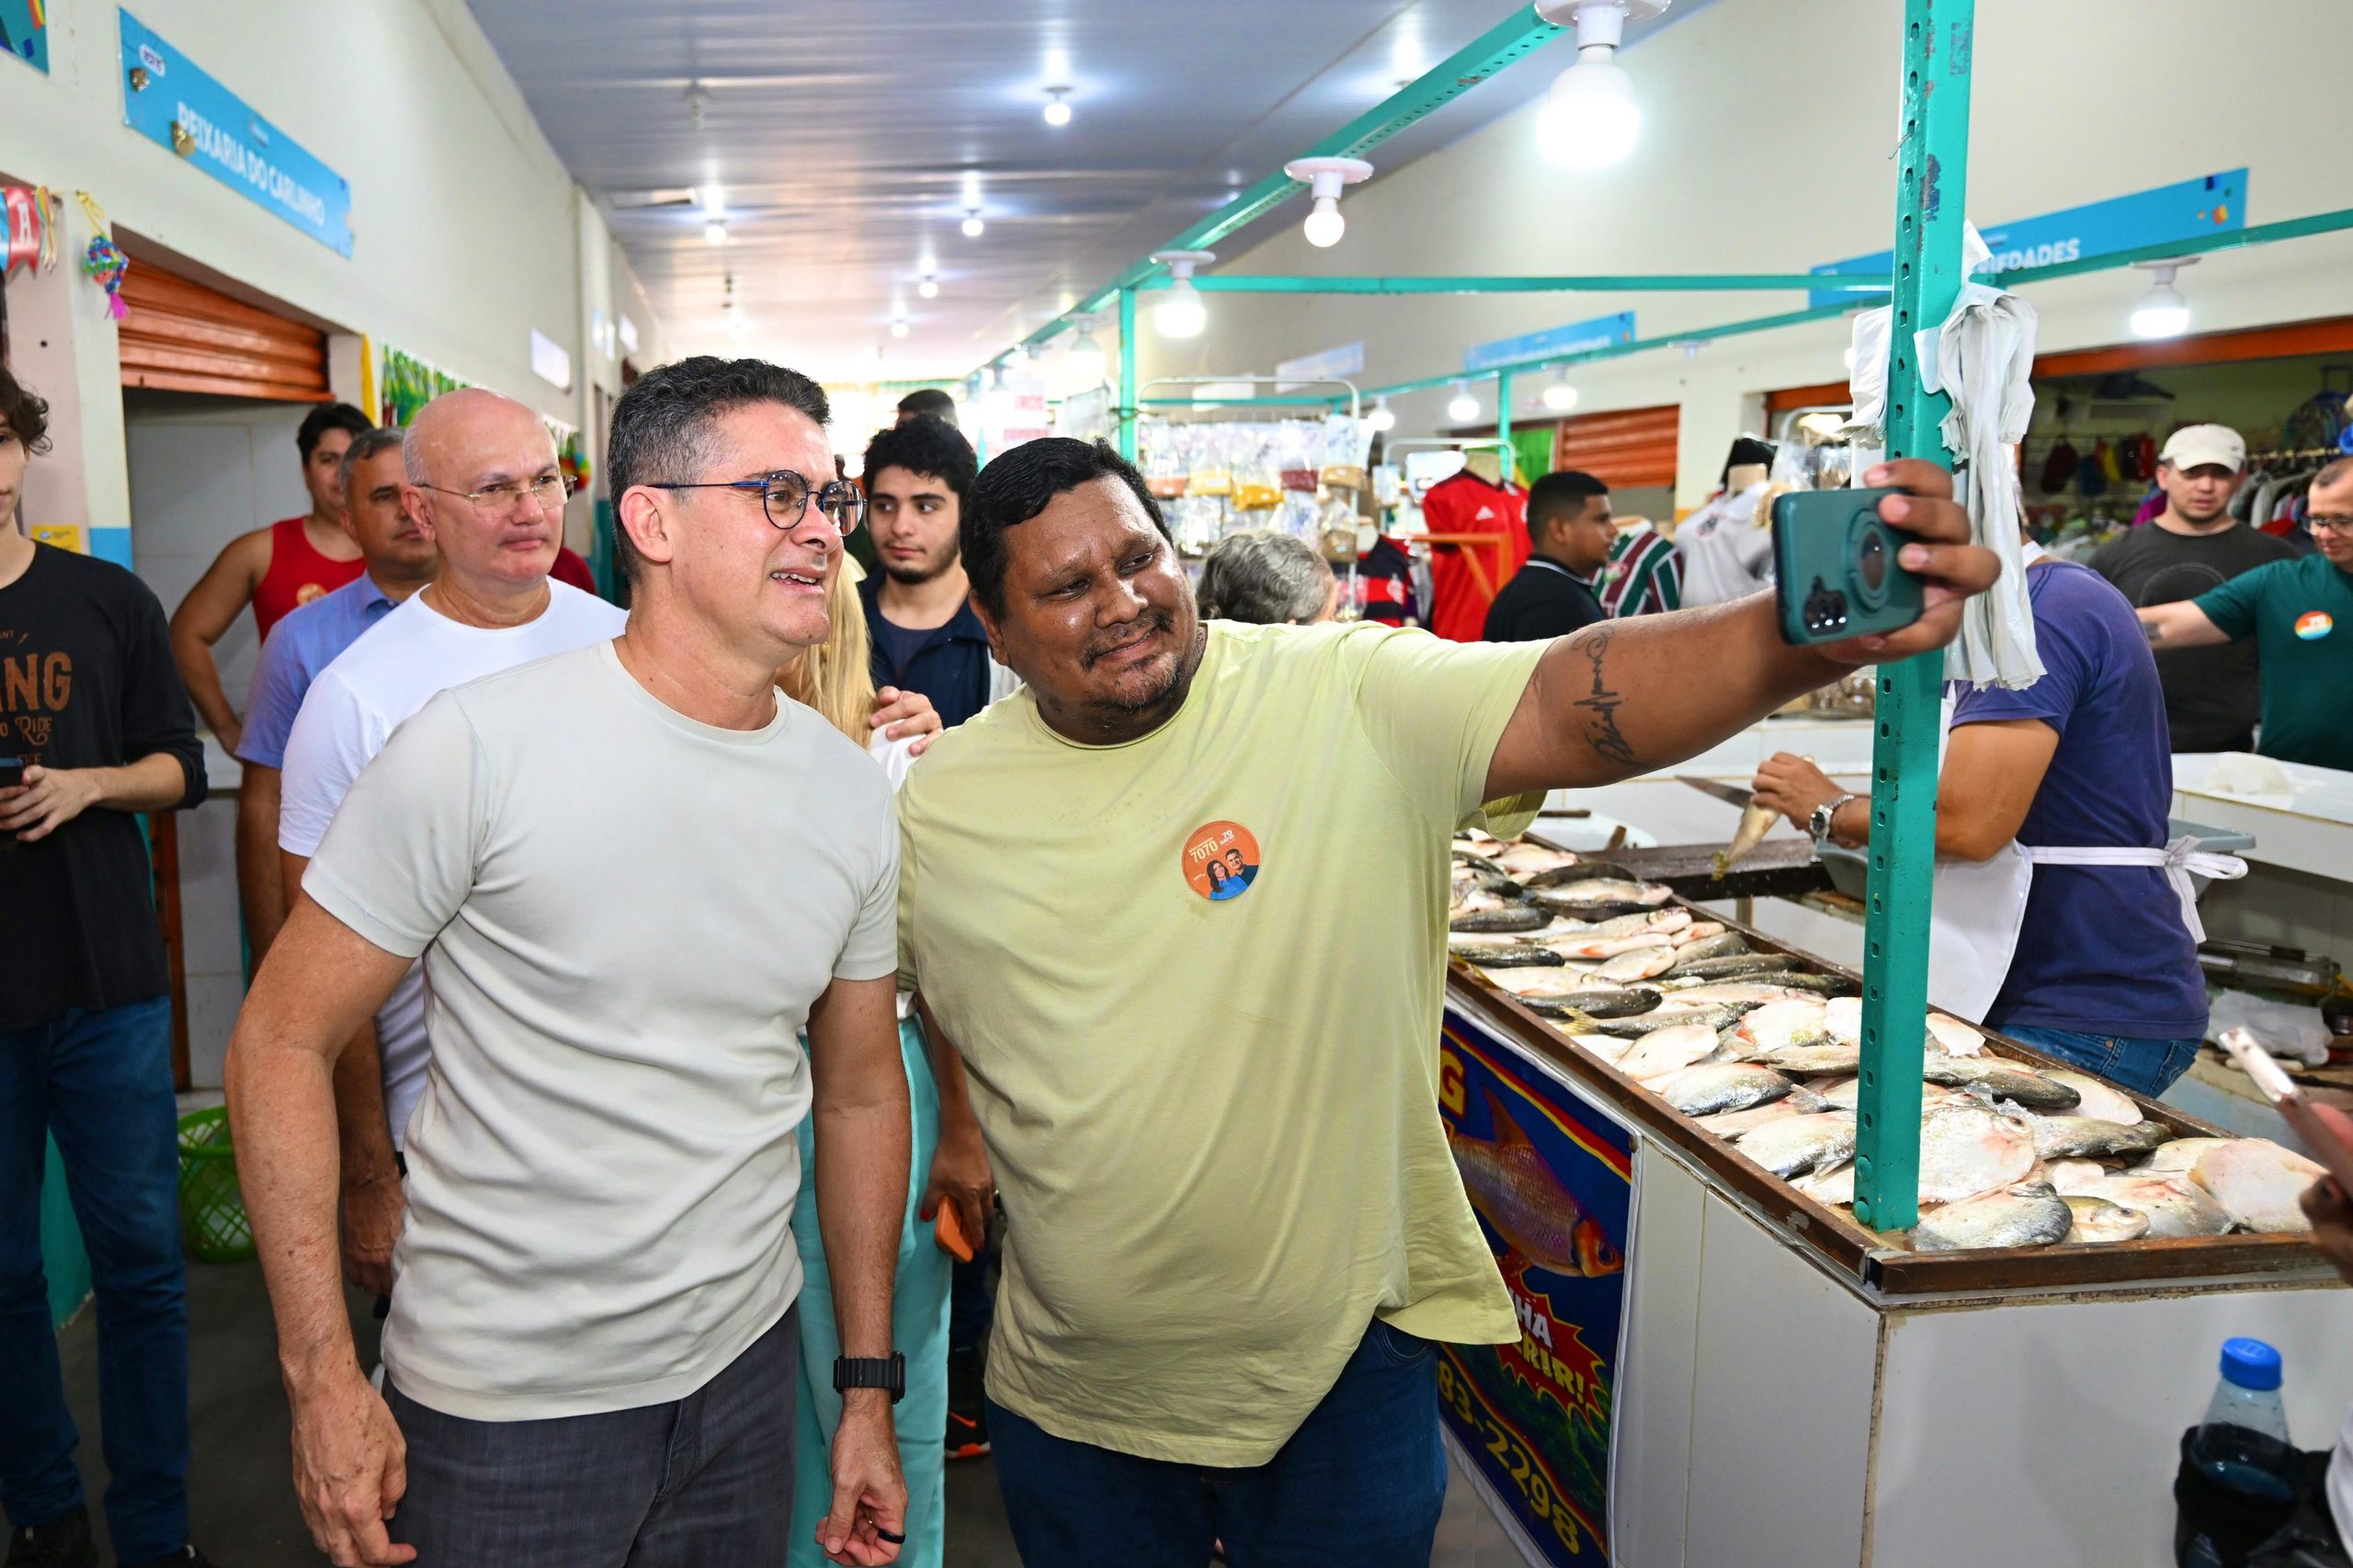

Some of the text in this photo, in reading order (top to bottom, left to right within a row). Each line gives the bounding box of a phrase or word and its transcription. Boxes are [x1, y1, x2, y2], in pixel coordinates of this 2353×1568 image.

[246, 149, 267, 191] DO
[0, 652, 72, 711] NG
[1189, 840, 1219, 864] 7070
[1508, 1287, 1553, 1349] HA
